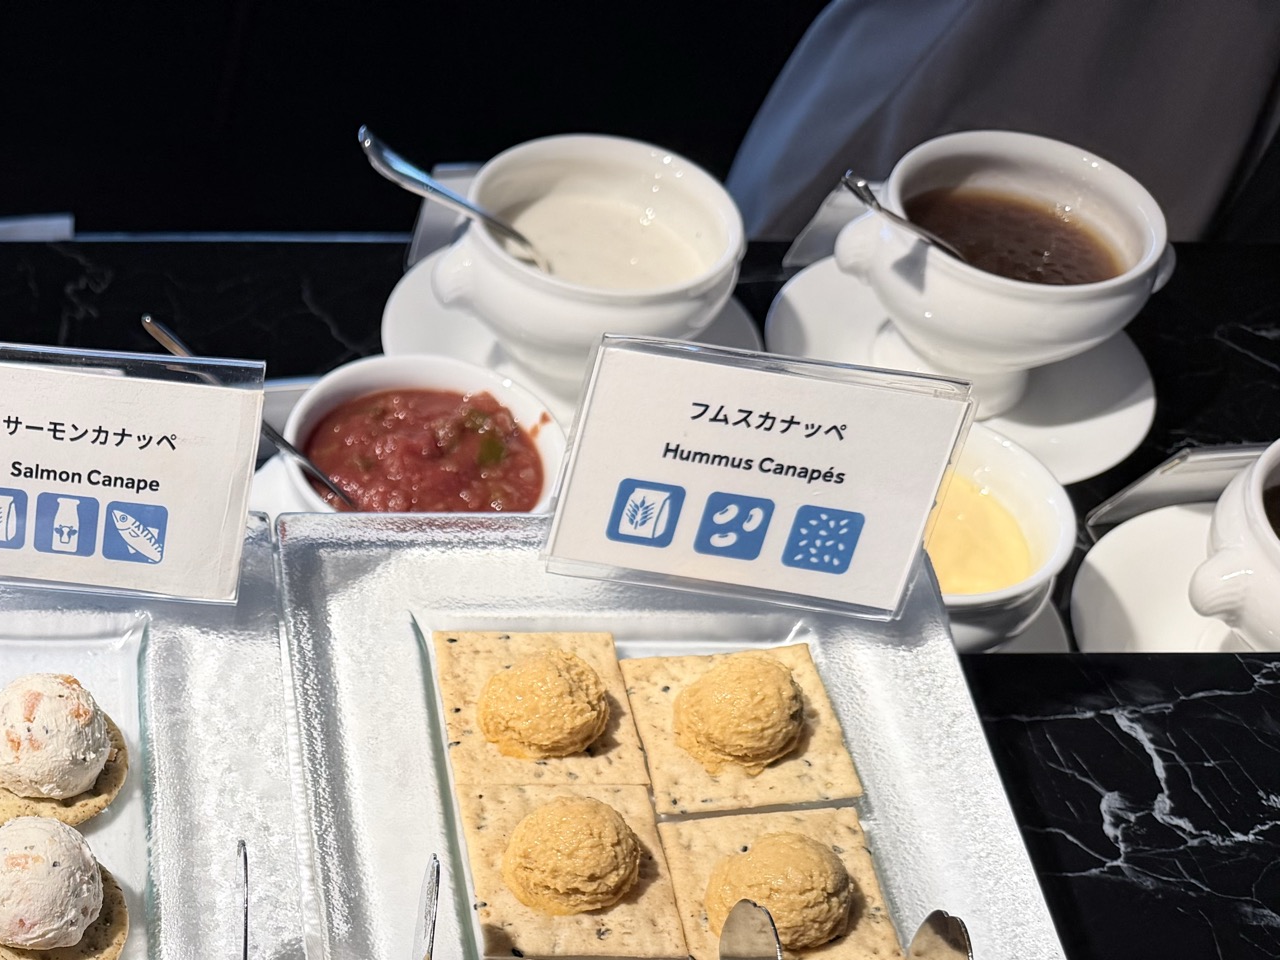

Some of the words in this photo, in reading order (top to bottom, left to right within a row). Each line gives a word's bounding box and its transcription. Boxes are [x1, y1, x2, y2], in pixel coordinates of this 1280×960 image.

[2, 415, 177, 451] サーモンカナッペ
[690, 402, 847, 441] フムスカナッペ
[10, 461, 82, 484] Salmon
[86, 469, 160, 494] Canape
[662, 442, 754, 471] Hummus
[758, 457, 846, 484] Canapés
